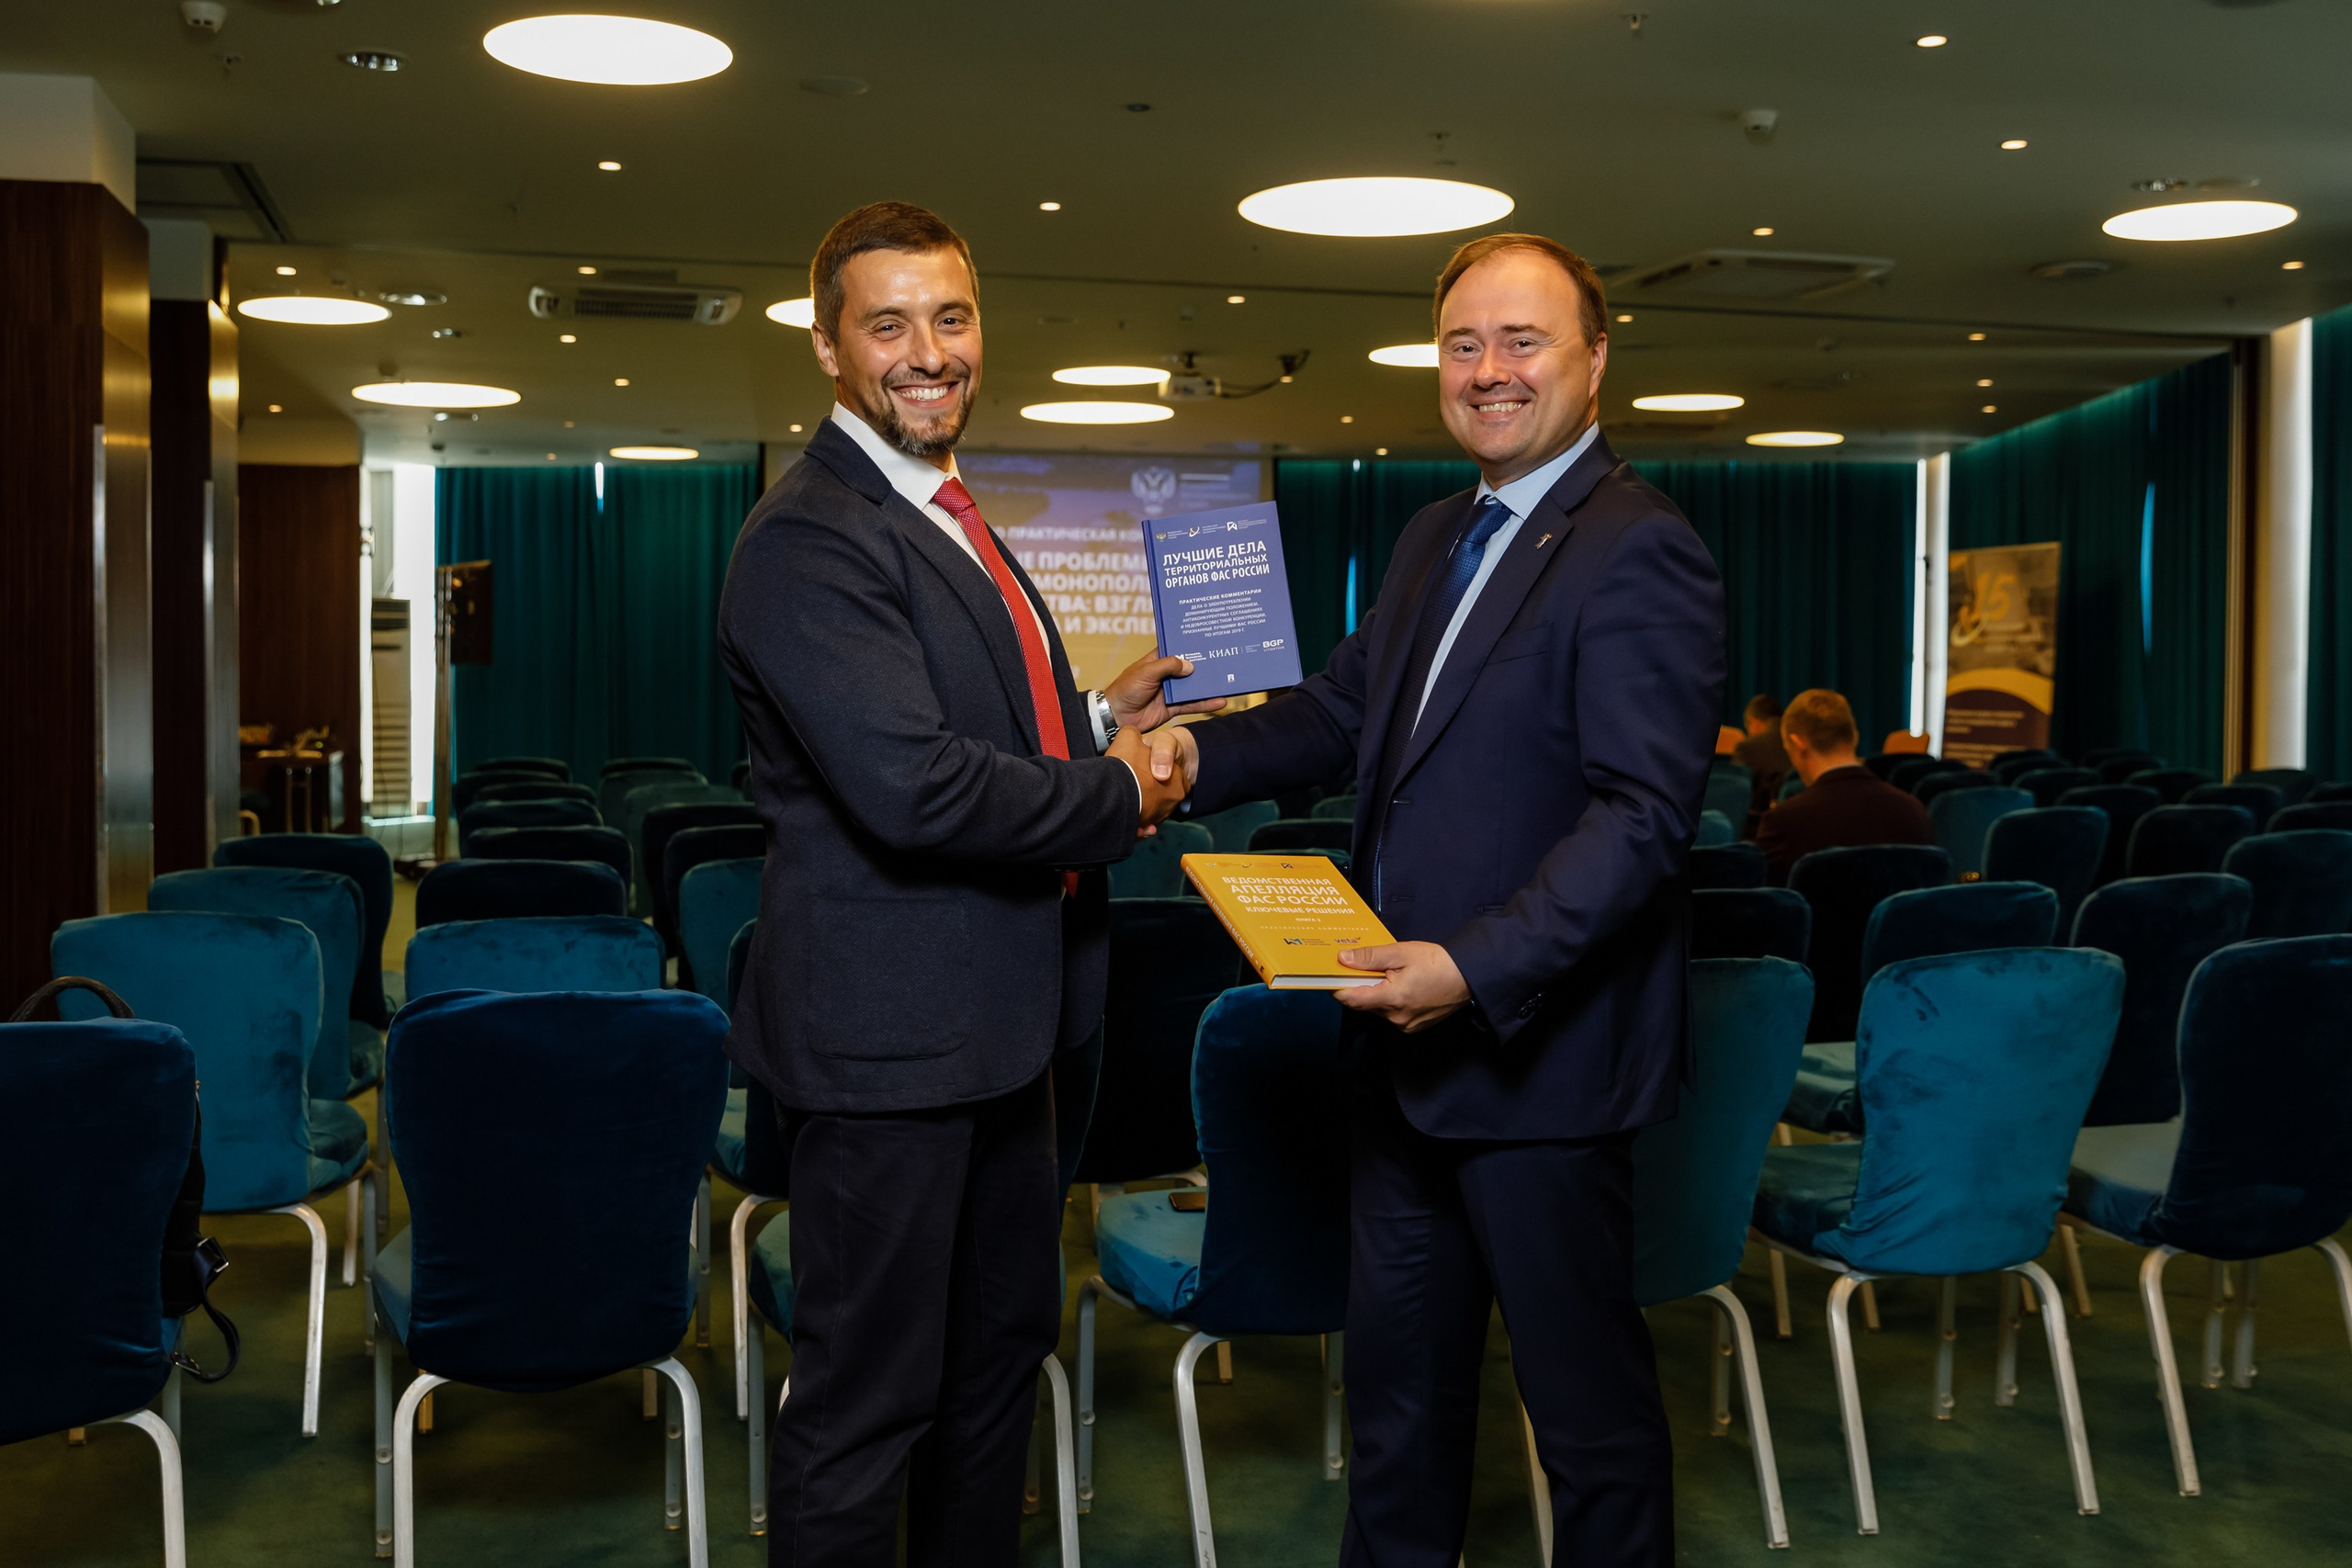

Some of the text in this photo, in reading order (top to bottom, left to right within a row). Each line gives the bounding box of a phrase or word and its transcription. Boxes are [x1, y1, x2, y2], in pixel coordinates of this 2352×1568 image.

[1163, 541, 1266, 566] ЛУЧШИЕ ДЕЛА
[1165, 554, 1267, 576] ТЕРРИТОРИАЛЬНЫХ
[1165, 564, 1270, 588] ОРГАНОВ ФАС РОССИИ
[1179, 588, 1262, 605] ПРАКТИЧЕСКИЕ КОММЕНТАРИИ
[1185, 607, 1225, 617] ДОМИНИРУЮЩИМ
[1262, 639, 1283, 649] BGP
[1209, 647, 1238, 658] КИАП
[1221, 876, 1331, 886] ВЕДОМСТВЕННАЯ
[1231, 885, 1340, 896] АПЕЛЛЯЦИЯ
[1237, 895, 1348, 905] ФАС РОССИИ
